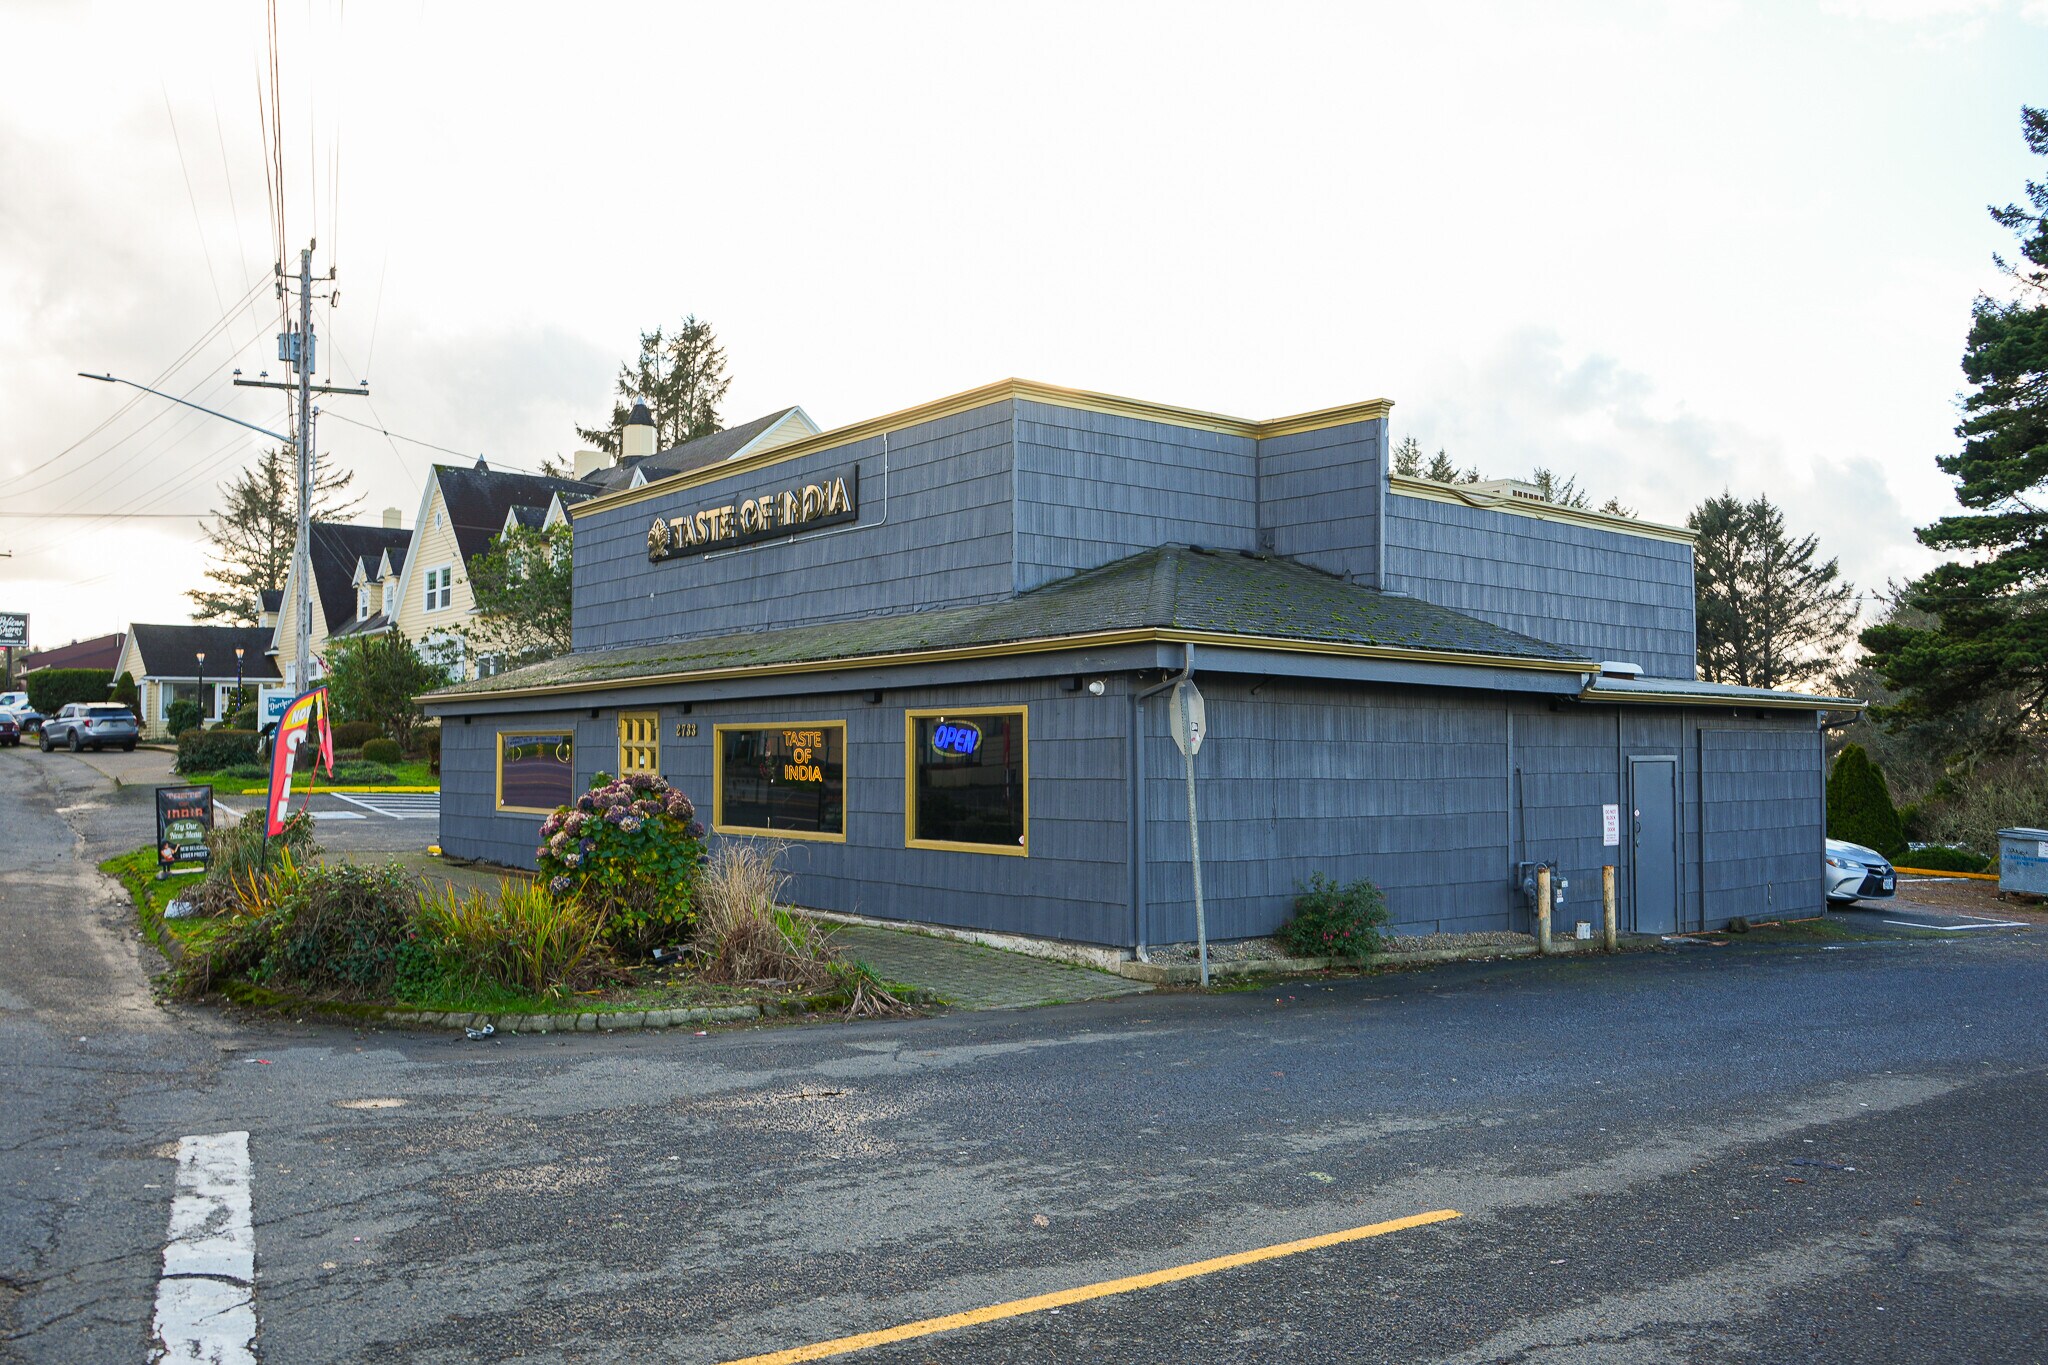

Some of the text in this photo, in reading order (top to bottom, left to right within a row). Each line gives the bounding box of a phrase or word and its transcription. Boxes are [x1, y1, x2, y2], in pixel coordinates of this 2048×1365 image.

[670, 477, 852, 549] TASTE OF INDIA
[676, 723, 697, 737] 2733
[783, 731, 822, 748] TASTE
[934, 725, 978, 754] OPEN
[793, 748, 812, 764] OF
[784, 764, 823, 782] INDIA
[173, 822, 197, 831] Try Our
